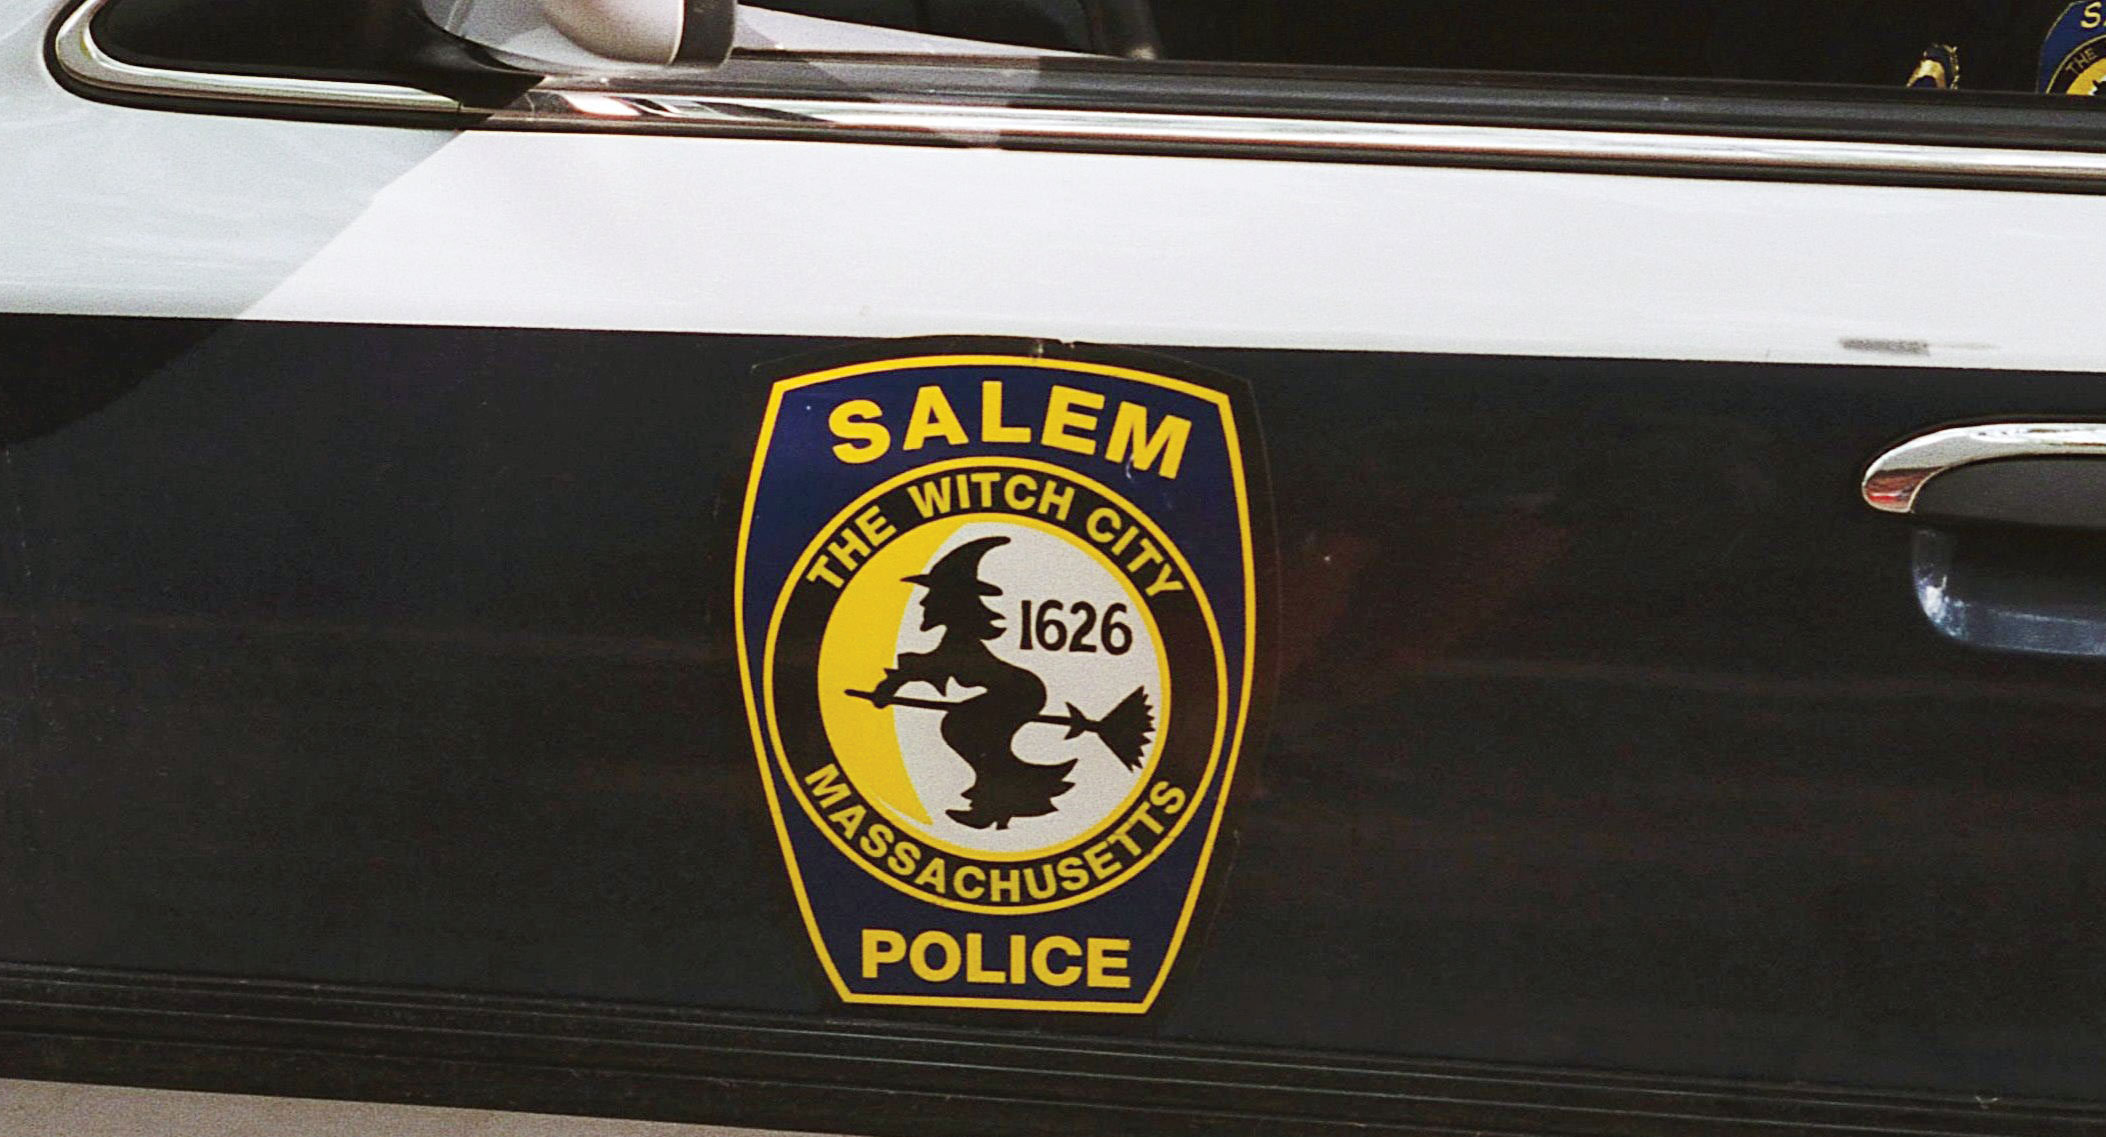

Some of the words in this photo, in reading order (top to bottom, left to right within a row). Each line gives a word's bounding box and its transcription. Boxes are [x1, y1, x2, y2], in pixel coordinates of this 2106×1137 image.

[2080, 1, 2106, 29] S
[2066, 48, 2098, 75] THE
[828, 381, 1192, 479] SALEM
[807, 505, 895, 590] THE
[908, 473, 1075, 521] WITCH
[1086, 508, 1184, 597] CITY
[1019, 600, 1133, 654] 1626
[804, 763, 1186, 902] MASSACHUSETTS
[861, 930, 1131, 988] POLICE
